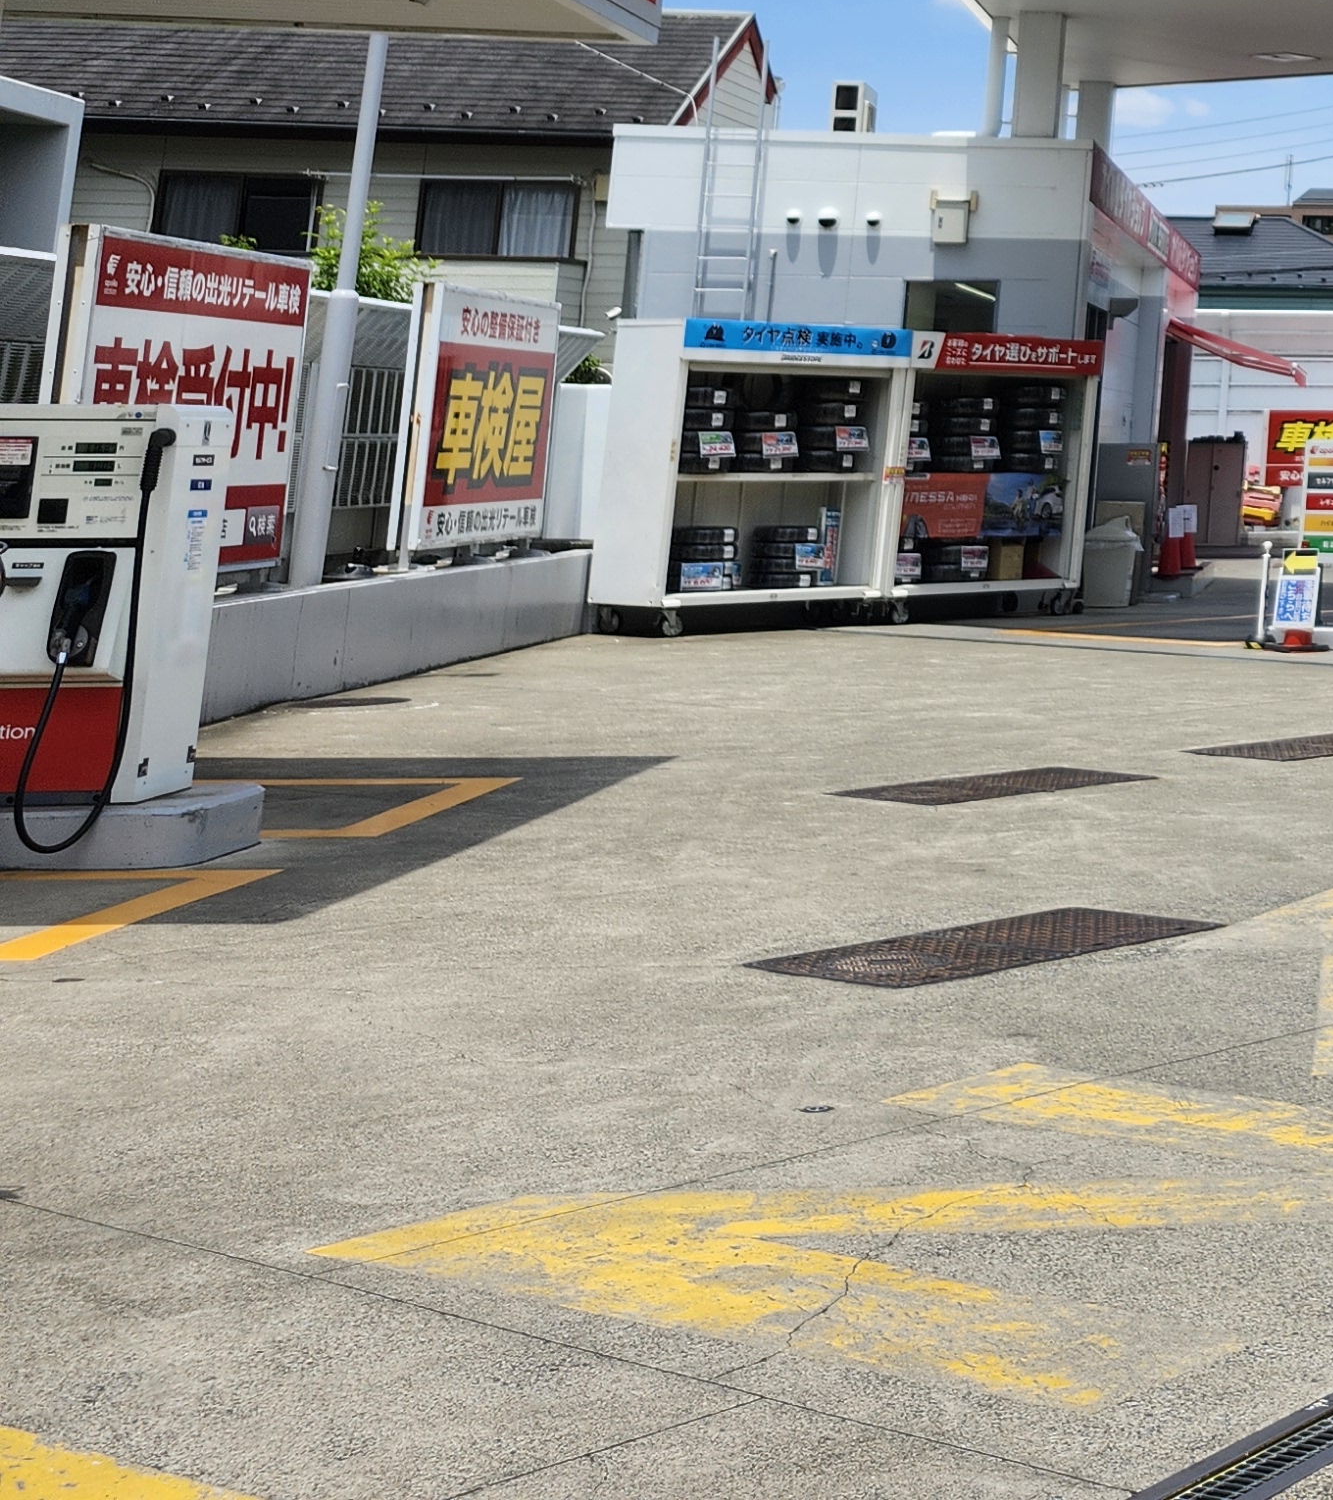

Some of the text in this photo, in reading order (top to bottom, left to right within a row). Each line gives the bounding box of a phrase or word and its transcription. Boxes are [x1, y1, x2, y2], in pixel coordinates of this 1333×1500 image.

[125, 260, 302, 315] 安心・信頼の出光リテール車検
[460, 306, 541, 344] 安心の整備保証付き
[436, 370, 546, 486] 車検屋
